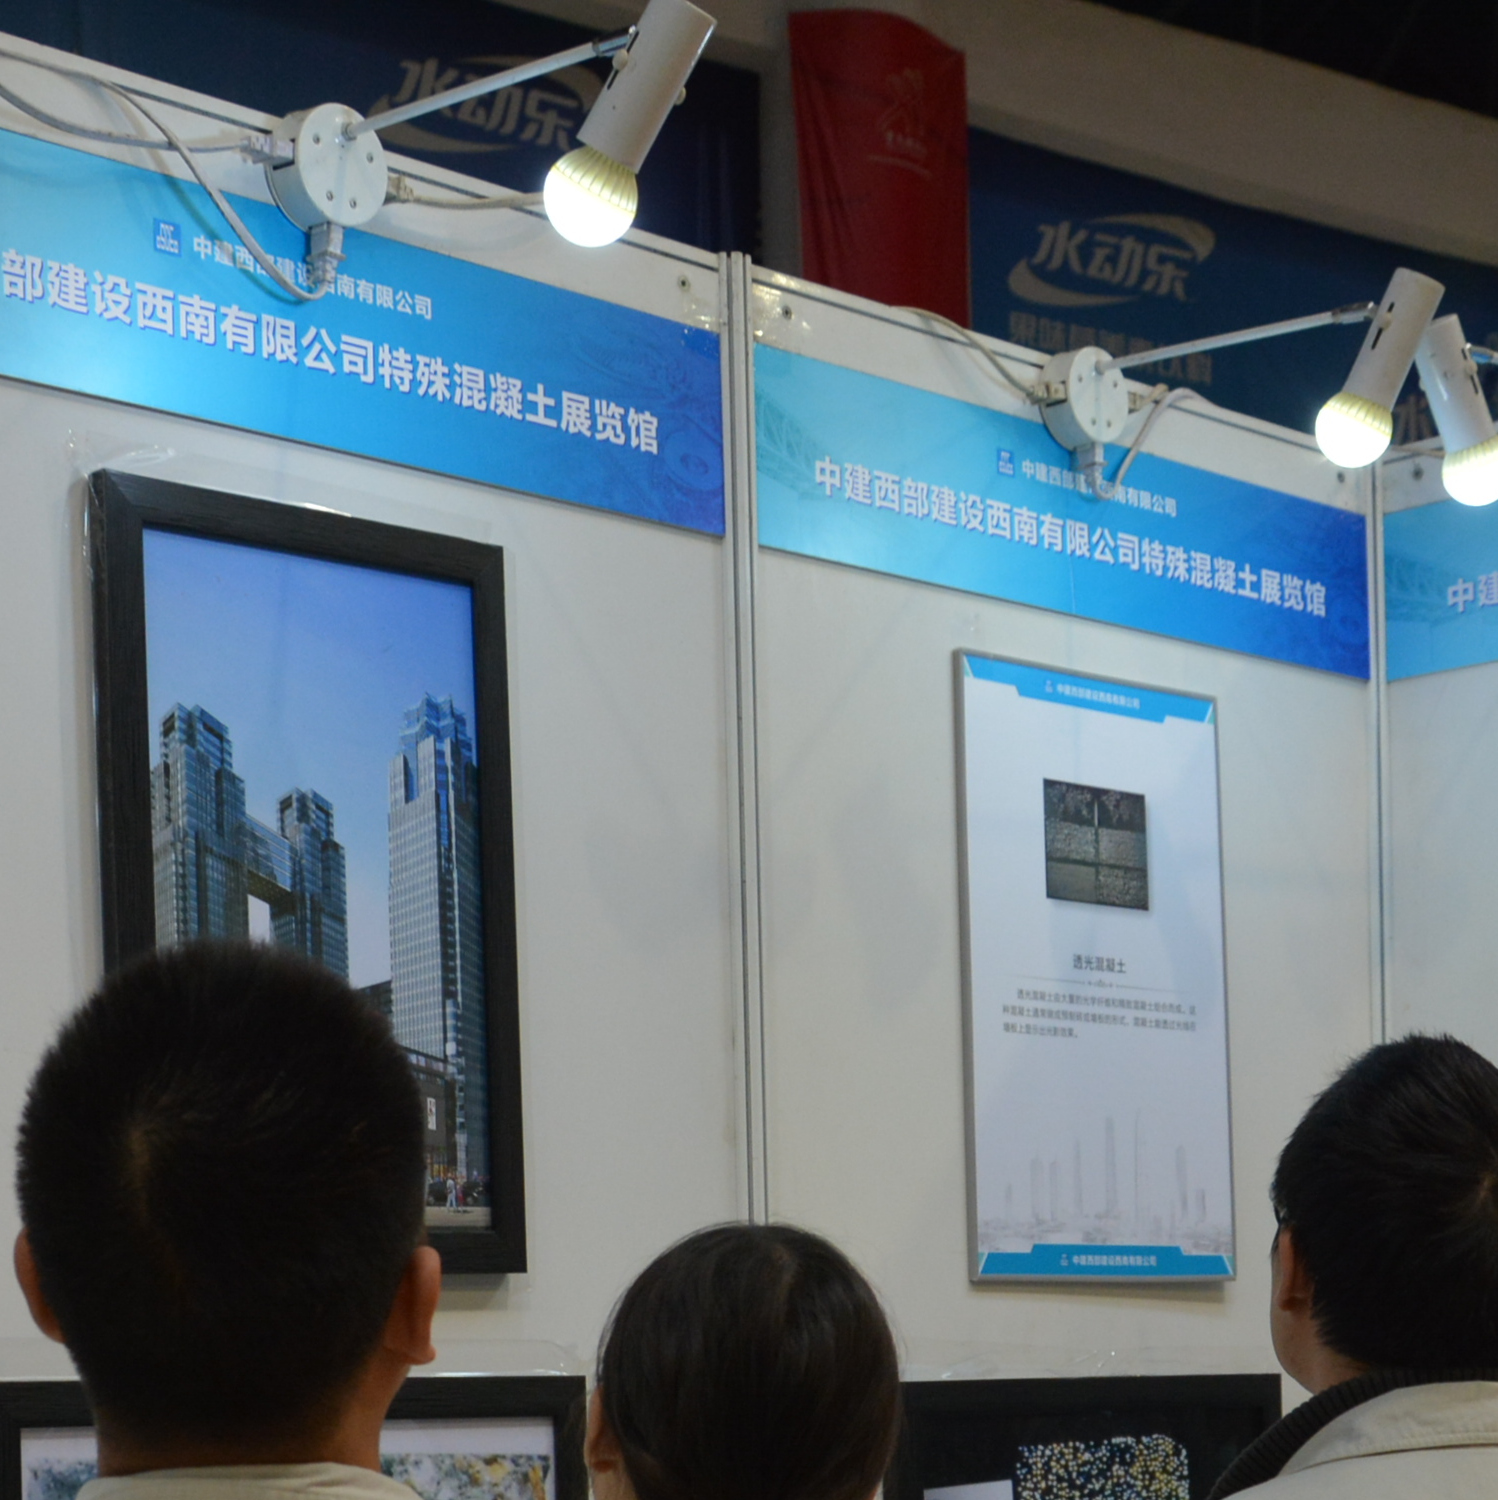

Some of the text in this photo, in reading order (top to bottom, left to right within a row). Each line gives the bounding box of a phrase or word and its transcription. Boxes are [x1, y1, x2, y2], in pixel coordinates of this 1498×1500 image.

[394, 57, 578, 150] 水动乐
[1031, 220, 1193, 301] 水动乐
[814, 455, 1328, 617] 中建西部建设西南有限公司特殊混凝土展览馆
